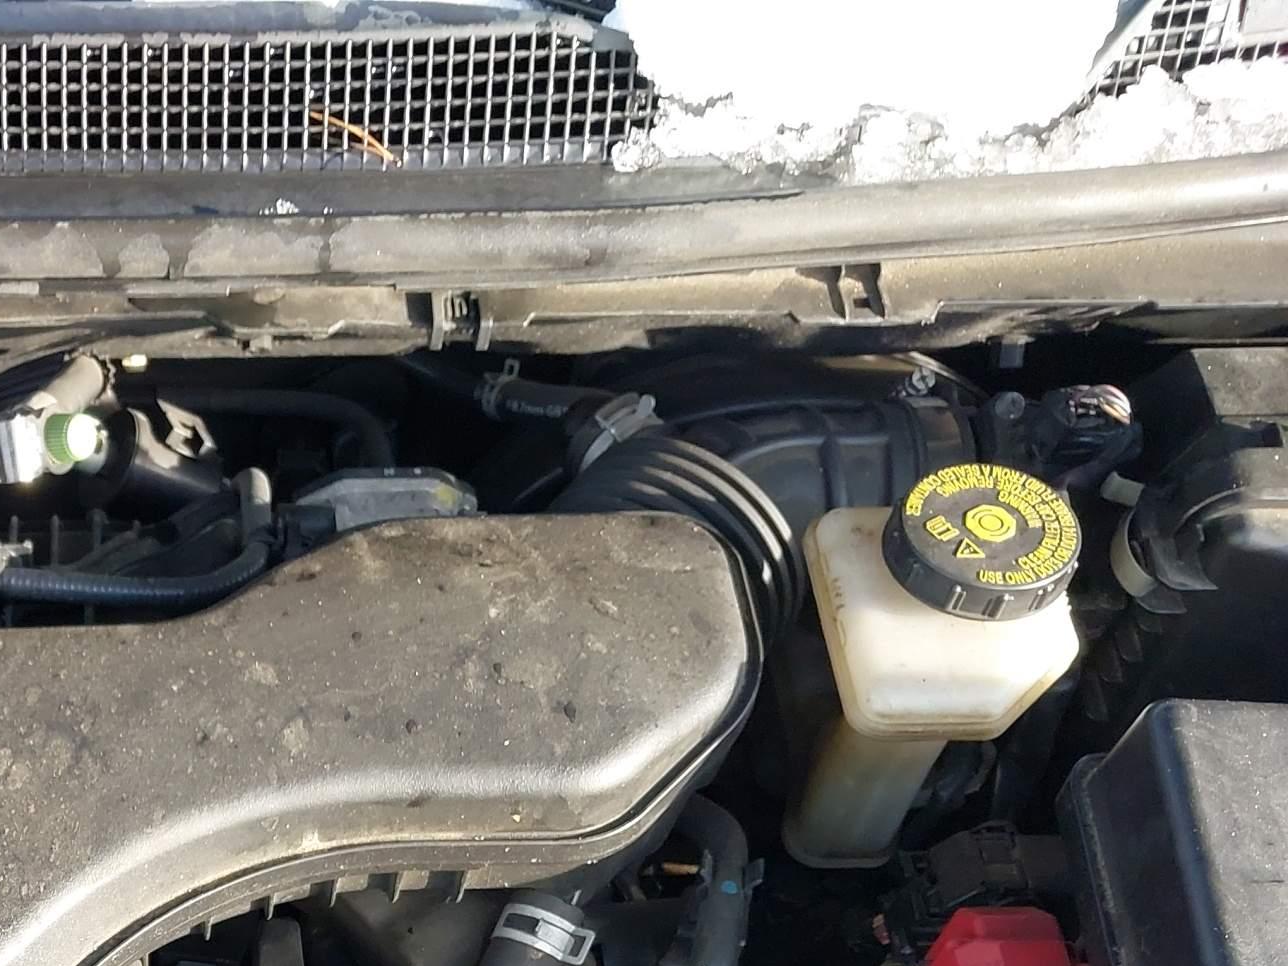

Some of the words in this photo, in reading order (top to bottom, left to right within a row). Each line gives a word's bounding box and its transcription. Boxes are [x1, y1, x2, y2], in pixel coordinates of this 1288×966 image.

[935, 465, 982, 483] SEALED
[993, 466, 1029, 486] FROM
[935, 477, 994, 498] REMOVING
[997, 479, 1043, 506] BEFORE
[1024, 478, 1057, 502] FLUID
[998, 491, 1042, 529] WARNING
[1034, 501, 1057, 521] CAP
[1048, 498, 1075, 527] BRAKE
[1041, 521, 1060, 551] FILLER
[1016, 546, 1054, 570] CLEAN
[1033, 557, 1065, 579] DOT3
[979, 570, 1004, 585] USE
[1005, 569, 1040, 585] ONLY
